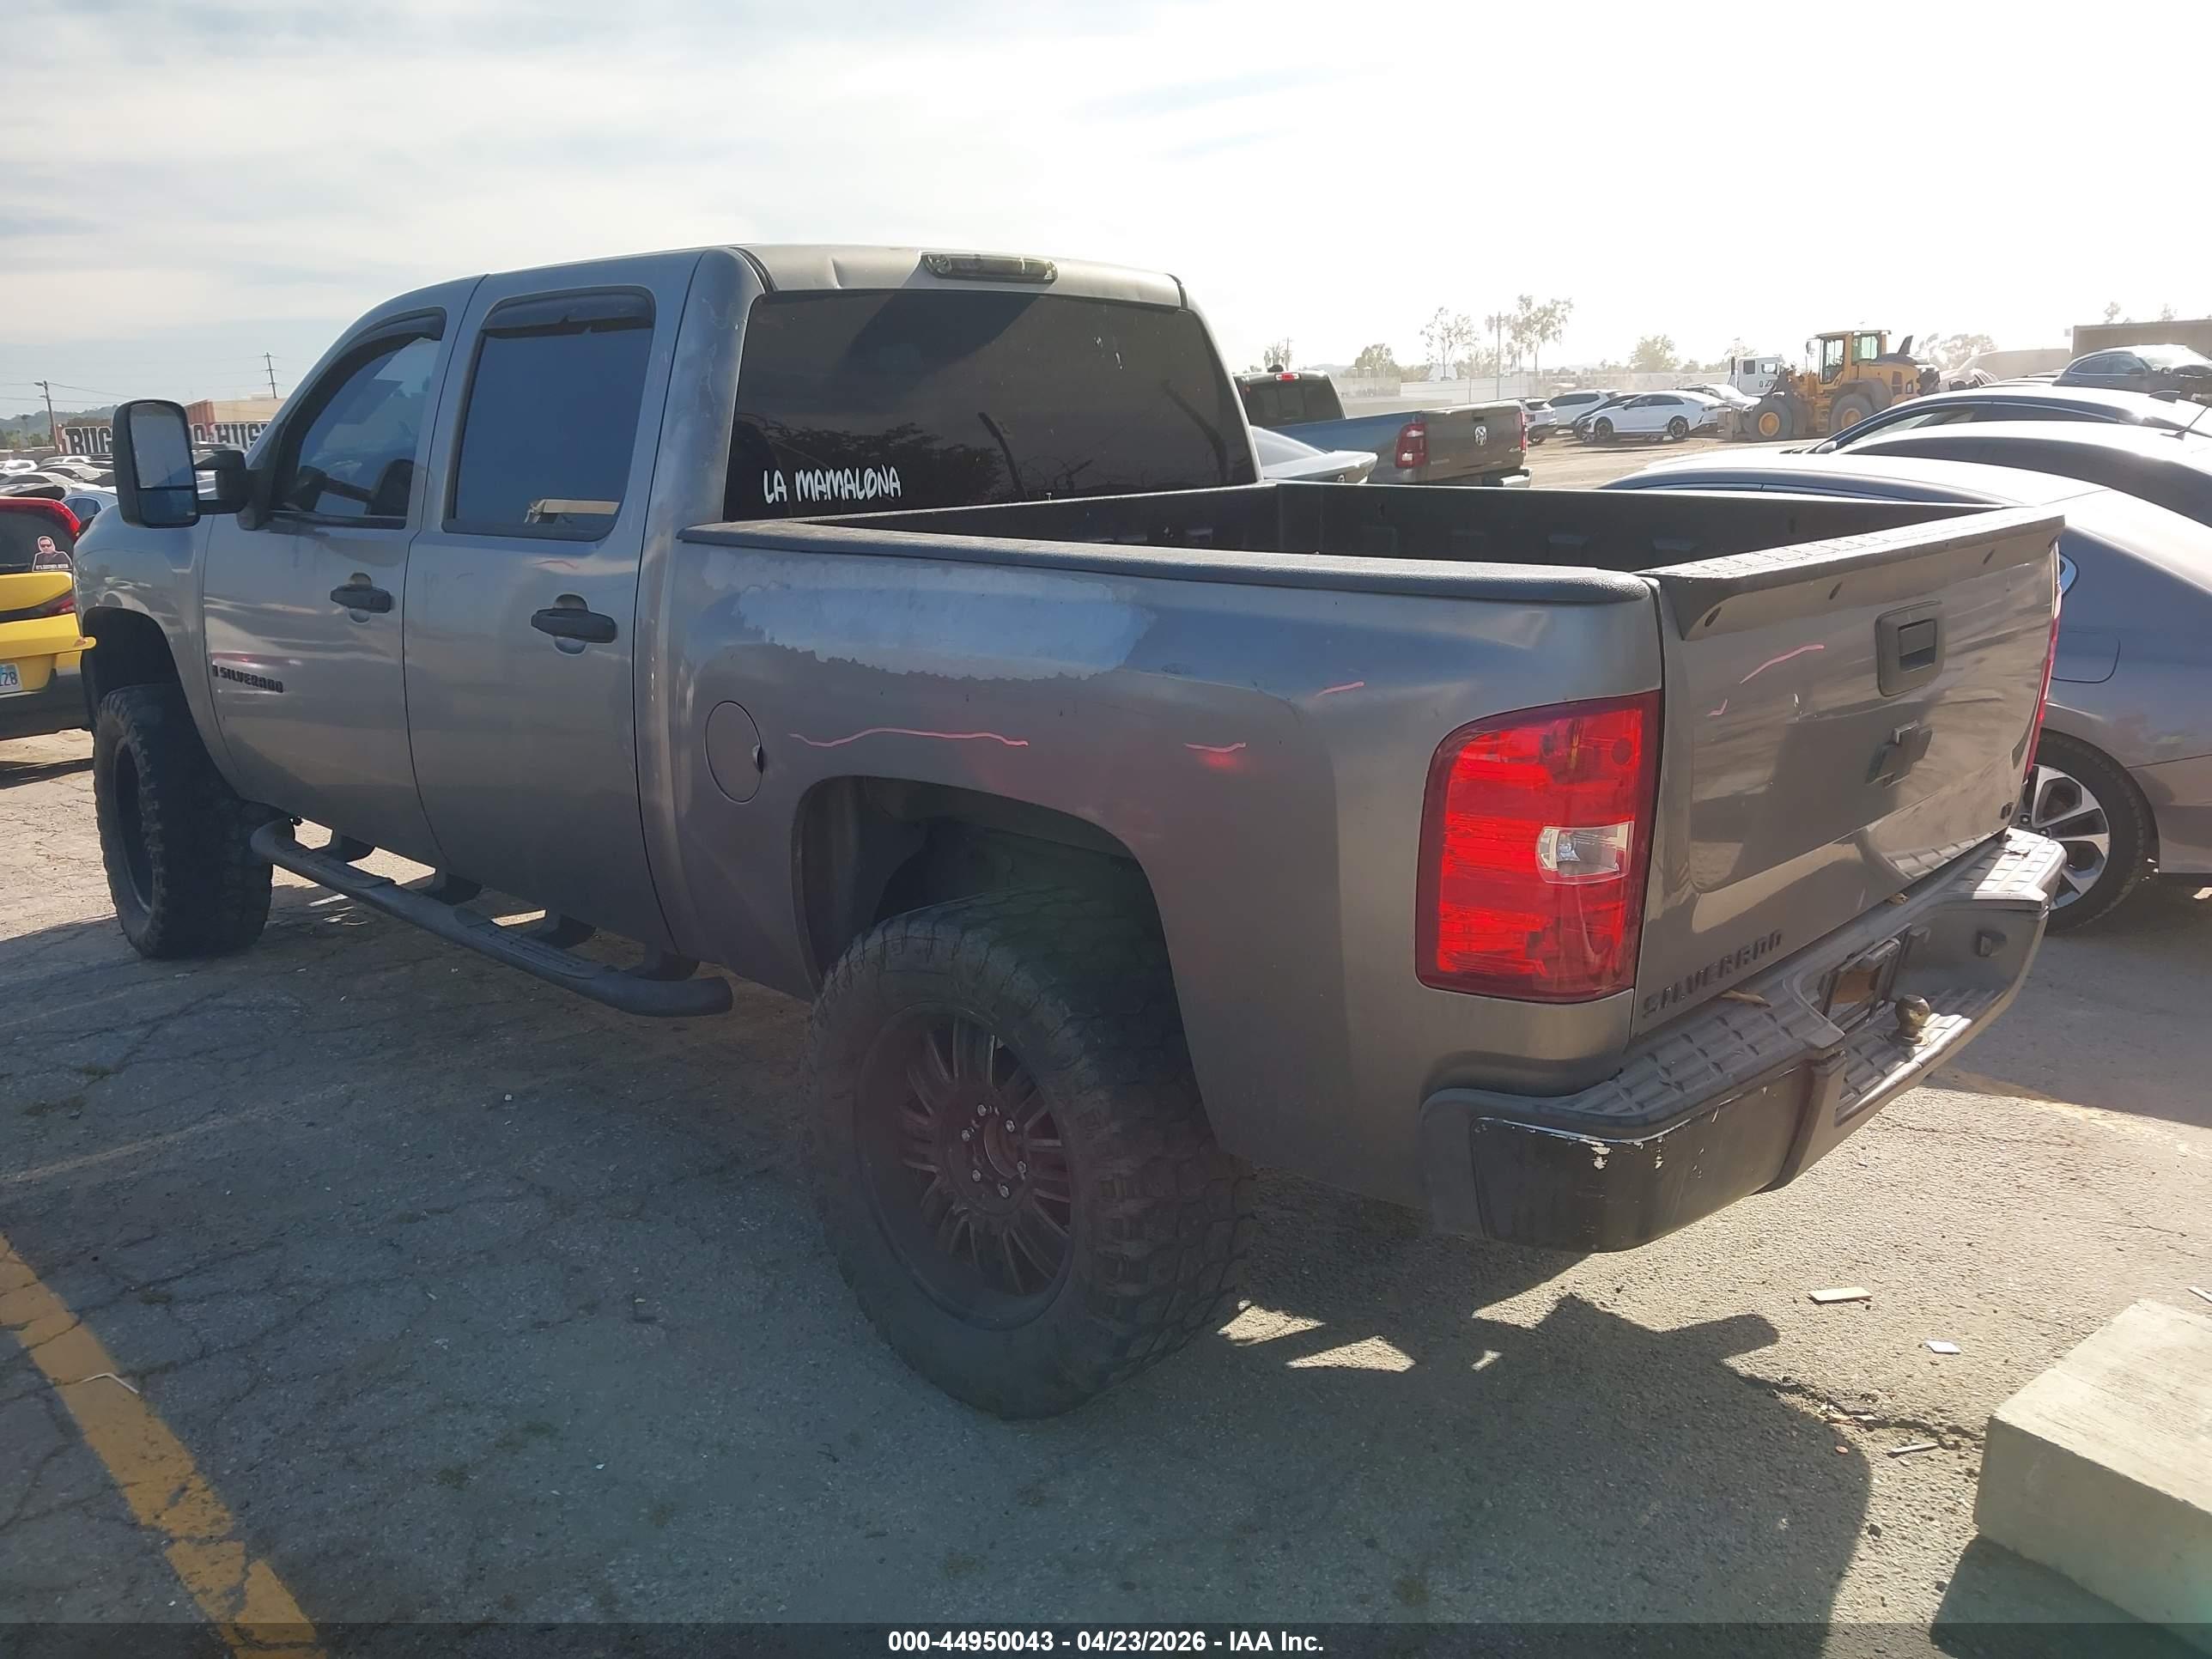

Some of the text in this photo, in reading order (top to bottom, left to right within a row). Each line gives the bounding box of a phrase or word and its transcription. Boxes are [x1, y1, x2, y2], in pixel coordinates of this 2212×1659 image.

[763, 465, 902, 504] LA MAMALONA
[0, 672, 18, 687] 28
[220, 666, 283, 693] SILVERADO
[1642, 928, 1783, 1018] SILVERADO
